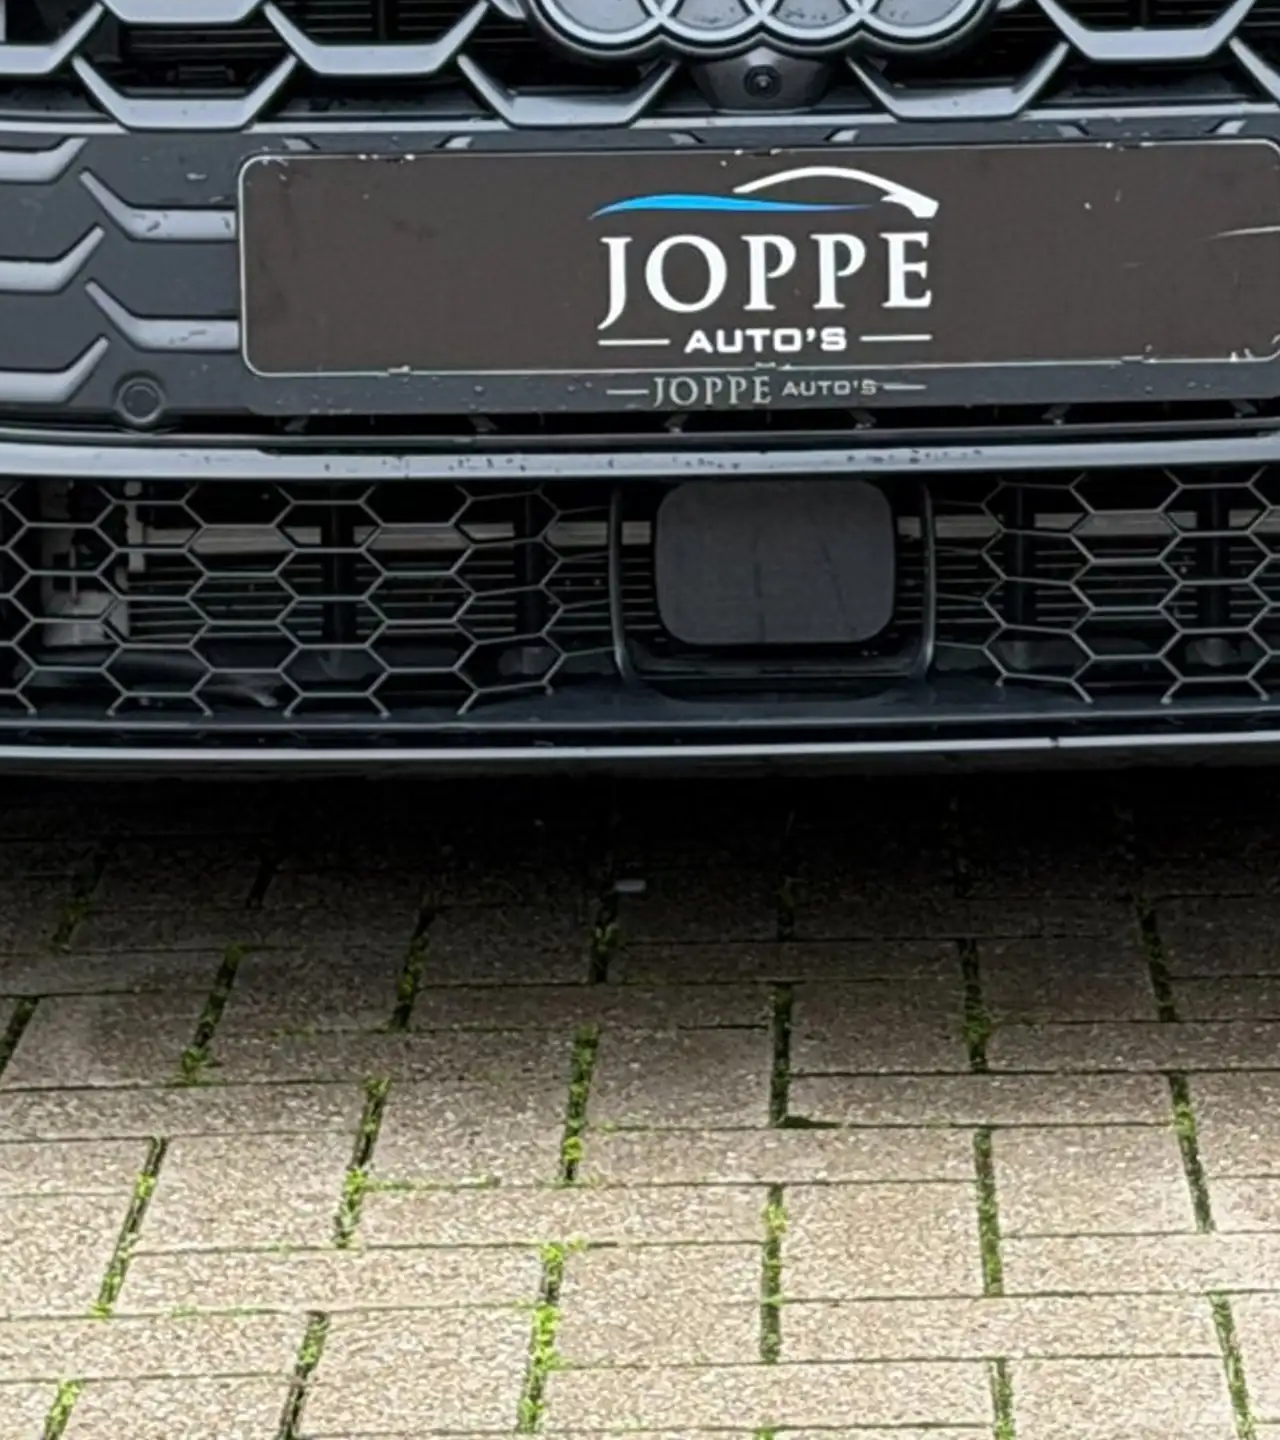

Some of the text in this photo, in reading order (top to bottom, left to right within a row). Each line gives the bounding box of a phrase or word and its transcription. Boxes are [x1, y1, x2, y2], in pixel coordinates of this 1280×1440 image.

[597, 231, 933, 330] JOPPE
[683, 327, 848, 354] AUTO'S
[652, 375, 877, 408] JOPPE AUTO'S
